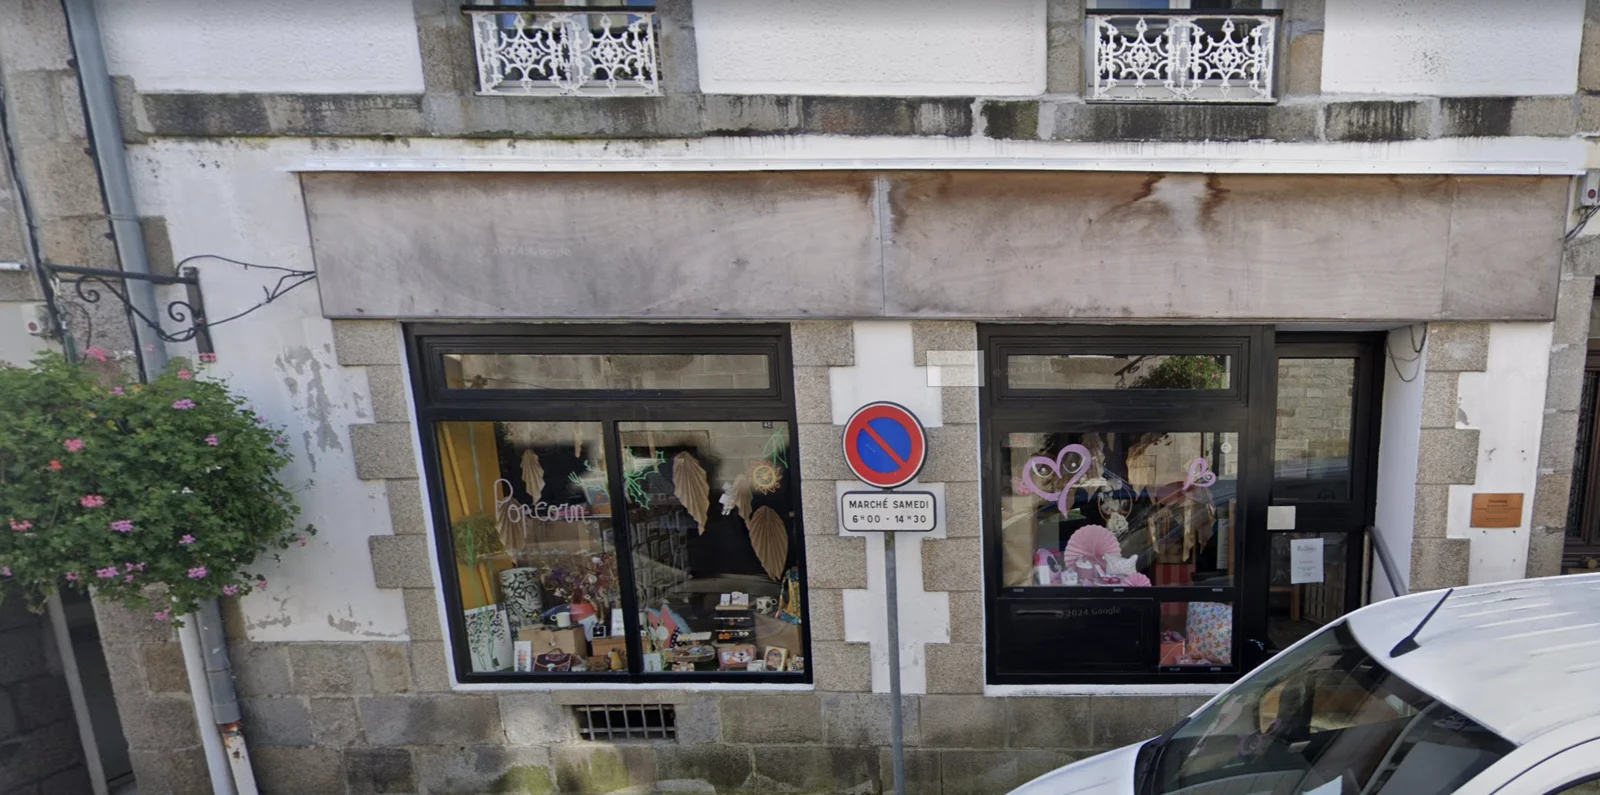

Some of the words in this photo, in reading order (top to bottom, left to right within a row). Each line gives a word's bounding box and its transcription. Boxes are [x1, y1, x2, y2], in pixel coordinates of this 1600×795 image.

[493, 478, 591, 538] Popcorn
[849, 498, 889, 509] MARCHÉ
[893, 500, 929, 509] SAMEDI
